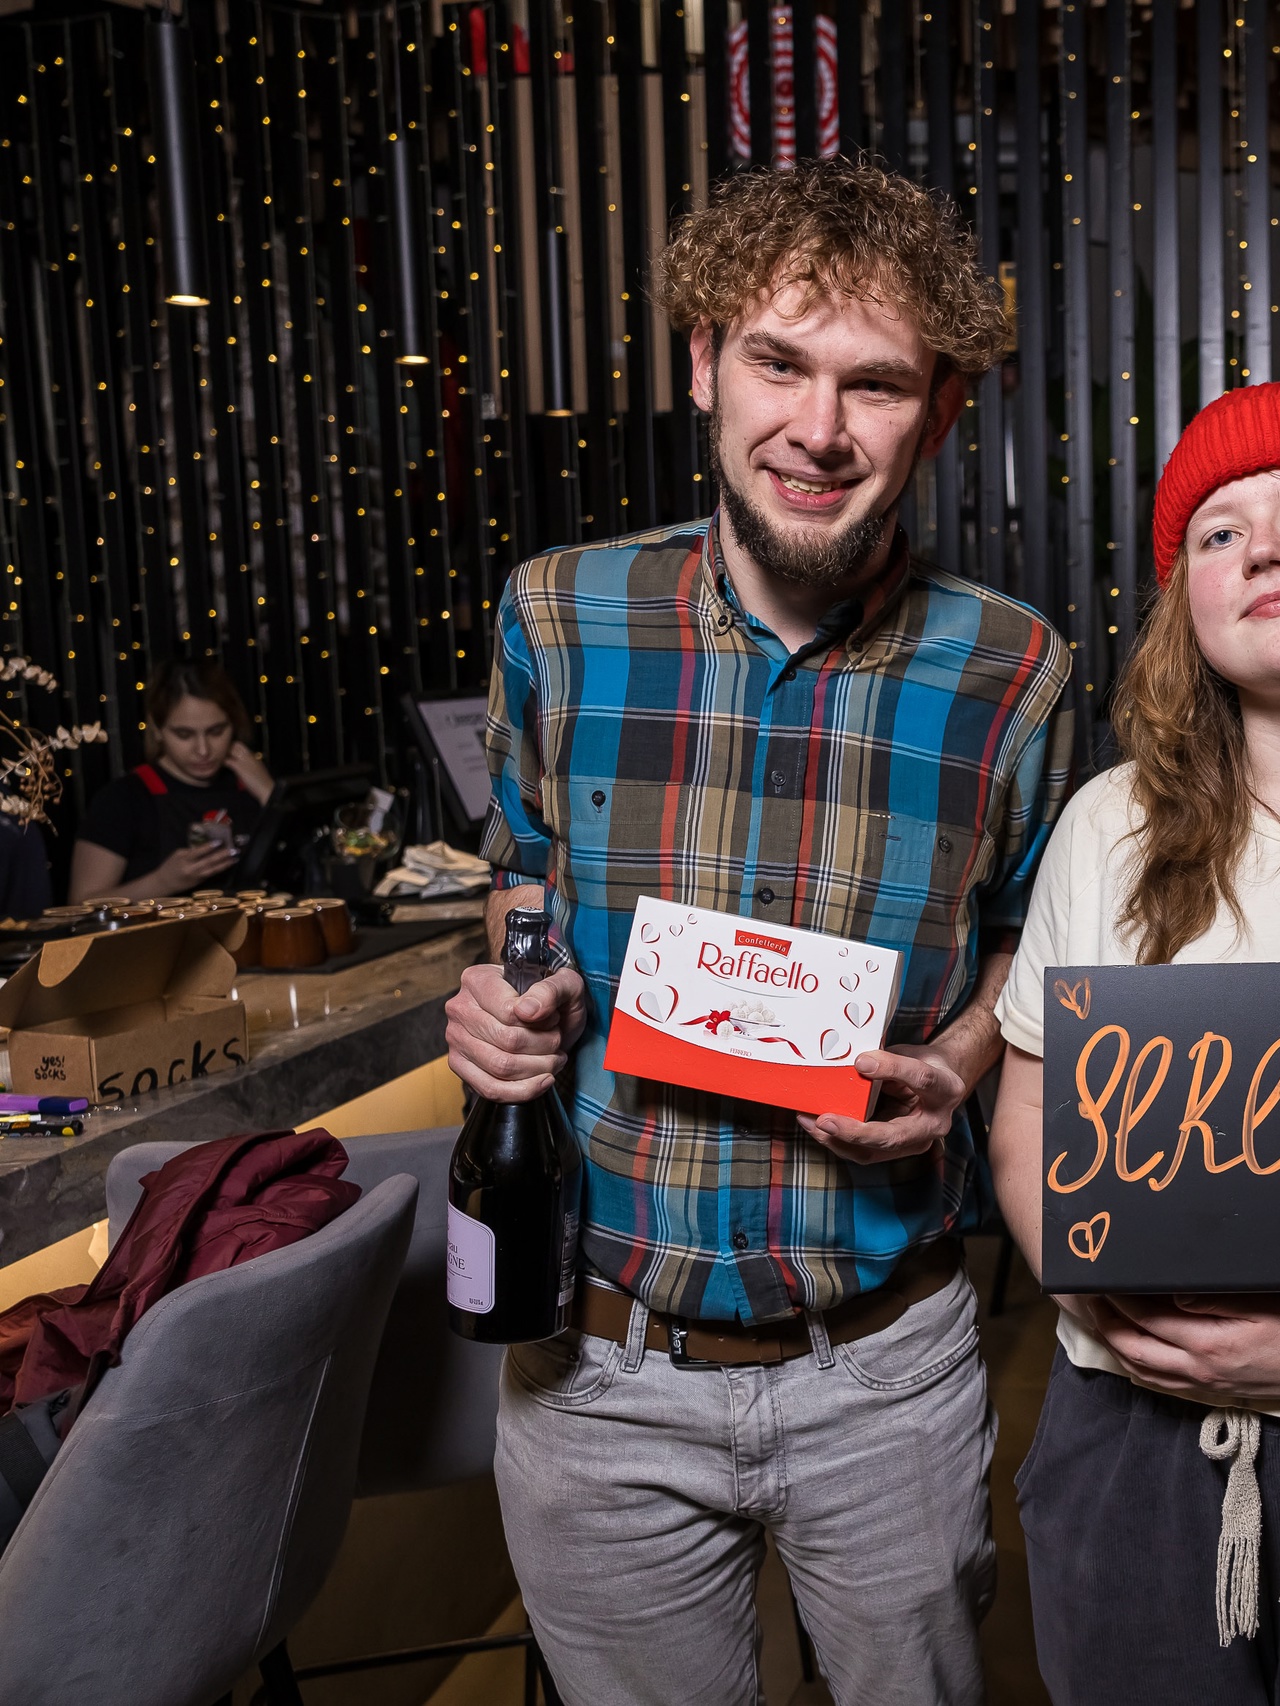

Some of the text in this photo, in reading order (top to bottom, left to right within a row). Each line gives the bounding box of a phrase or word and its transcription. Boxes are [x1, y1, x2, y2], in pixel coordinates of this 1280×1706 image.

[738, 934, 787, 953] Confetteria
[697, 941, 819, 994] Raffaello
[39, 1055, 65, 1071] yes!
